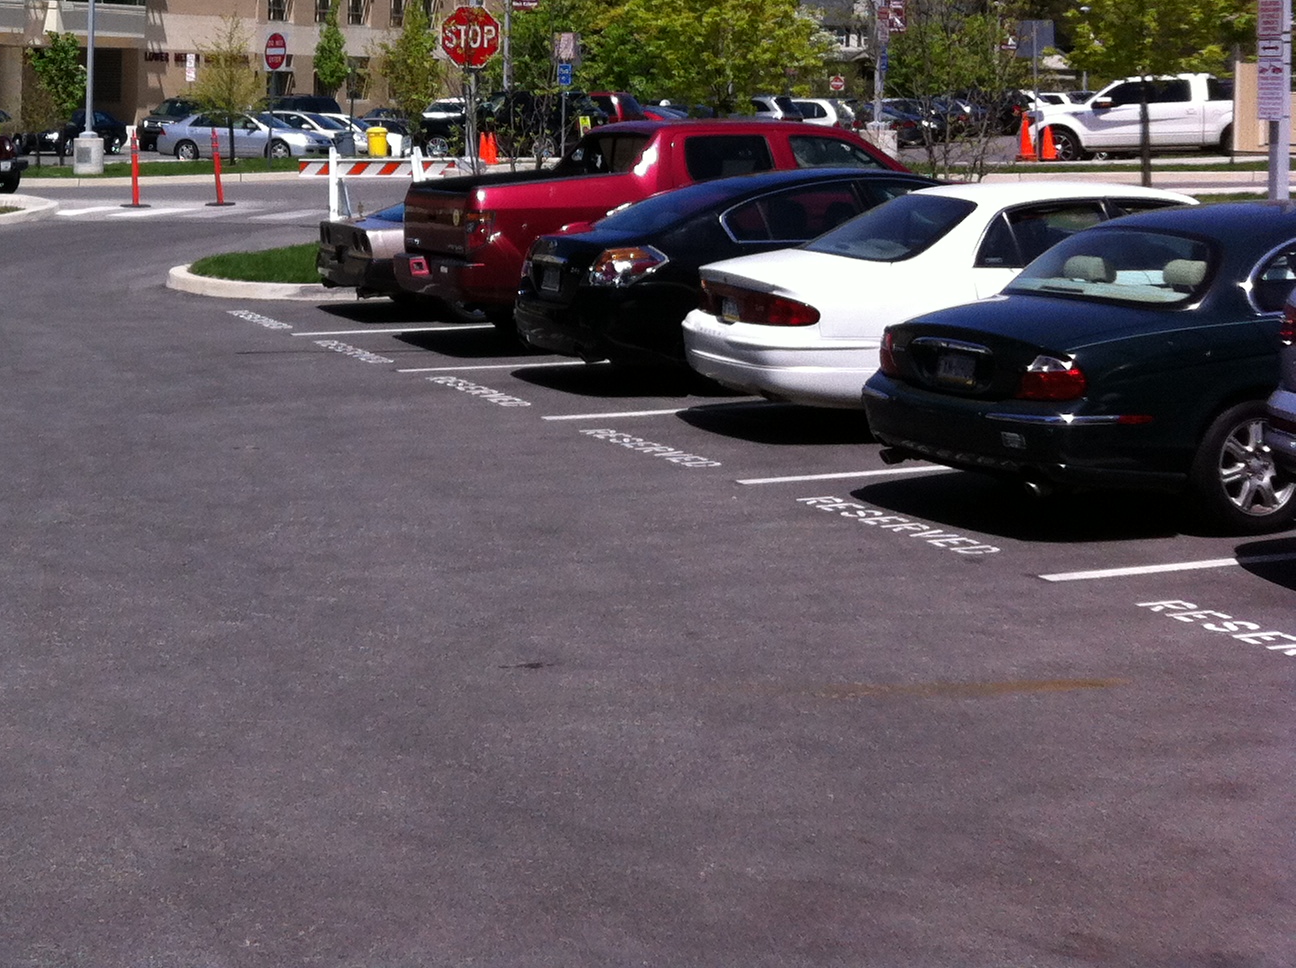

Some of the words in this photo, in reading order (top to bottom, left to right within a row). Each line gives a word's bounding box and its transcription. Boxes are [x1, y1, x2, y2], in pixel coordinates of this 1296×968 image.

[444, 25, 496, 49] STOP
[424, 375, 532, 407] RESERVED
[578, 428, 722, 467] RESERVED
[795, 495, 1001, 555] RESERVED
